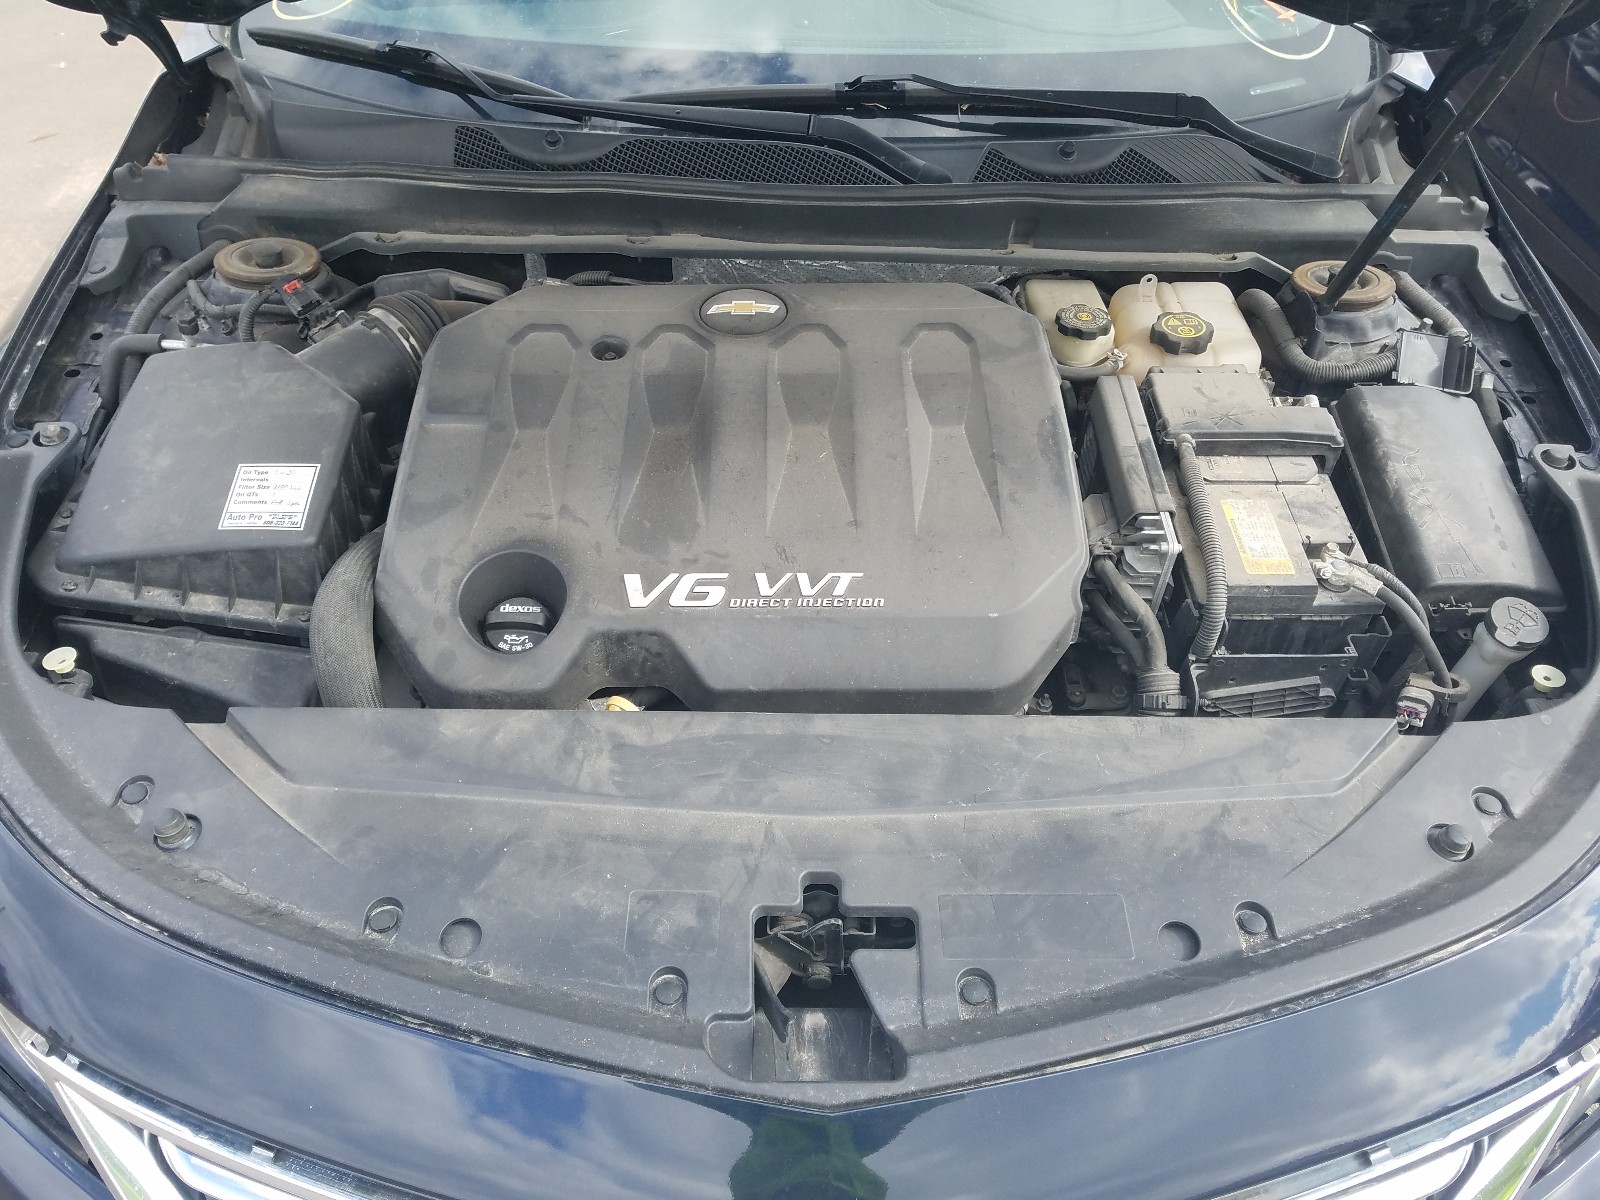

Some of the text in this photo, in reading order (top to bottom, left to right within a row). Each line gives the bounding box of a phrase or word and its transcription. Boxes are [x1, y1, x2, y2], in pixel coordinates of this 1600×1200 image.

[226, 513, 246, 521] Auto
[248, 513, 263, 521] Pro
[623, 572, 864, 608] V6 VVT
[499, 603, 543, 613] dexos
[729, 598, 885, 608] DIRECT INJECTION
[497, 641, 511, 651] SAE
